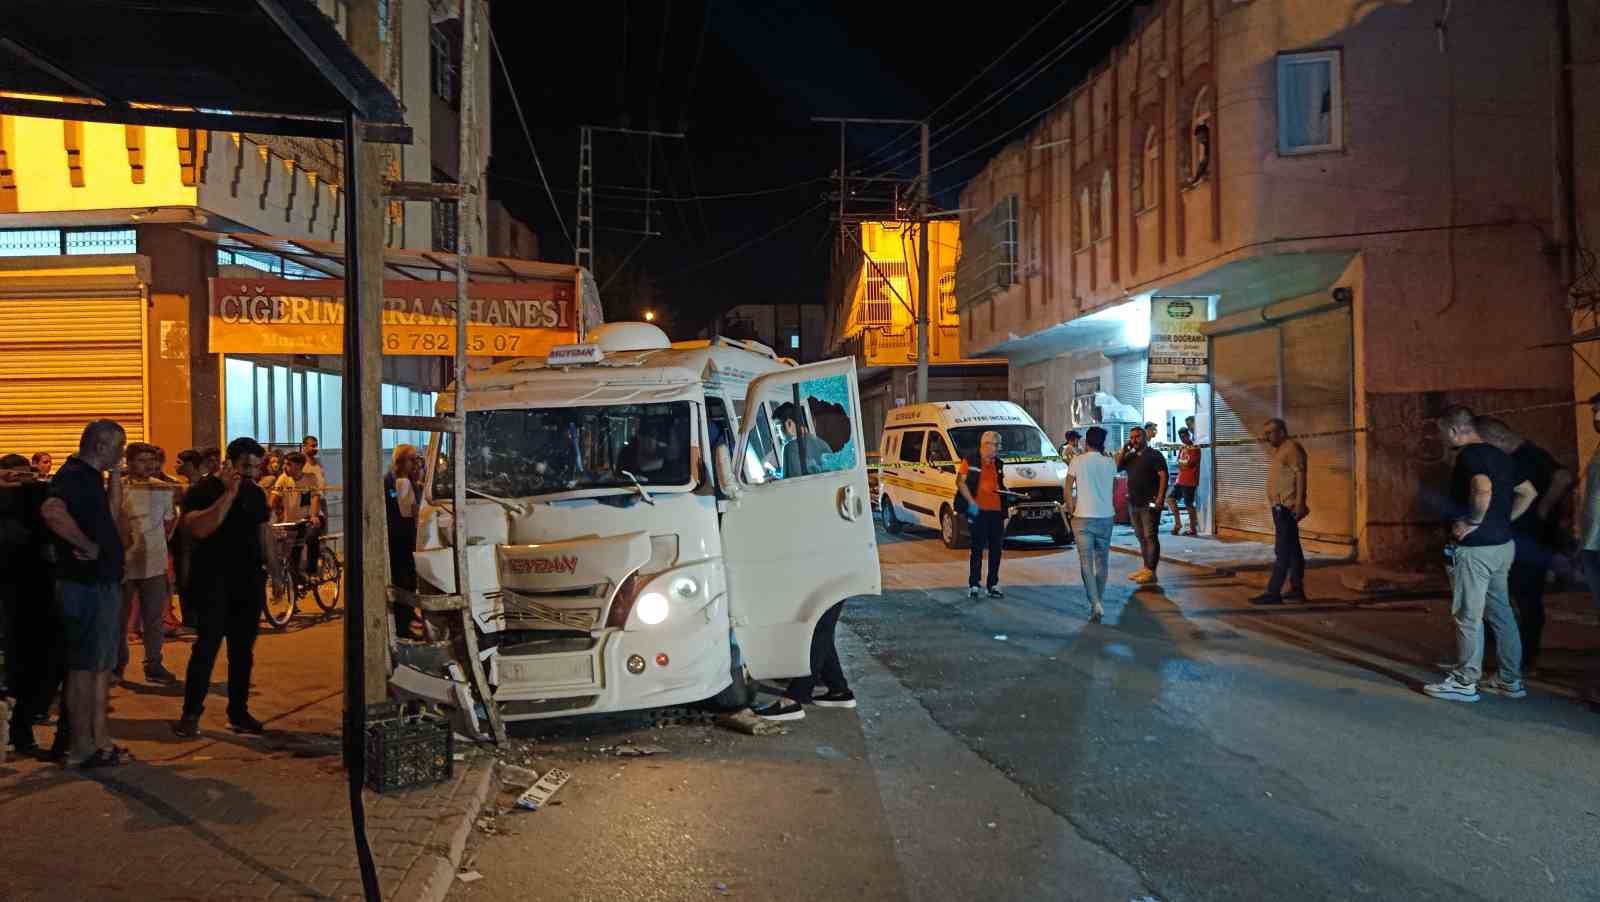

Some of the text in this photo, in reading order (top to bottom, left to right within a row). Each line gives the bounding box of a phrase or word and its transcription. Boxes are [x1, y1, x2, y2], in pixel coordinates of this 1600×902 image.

[384, 333, 400, 351] 6
[408, 334, 449, 351] 782
[494, 335, 520, 351] 07
